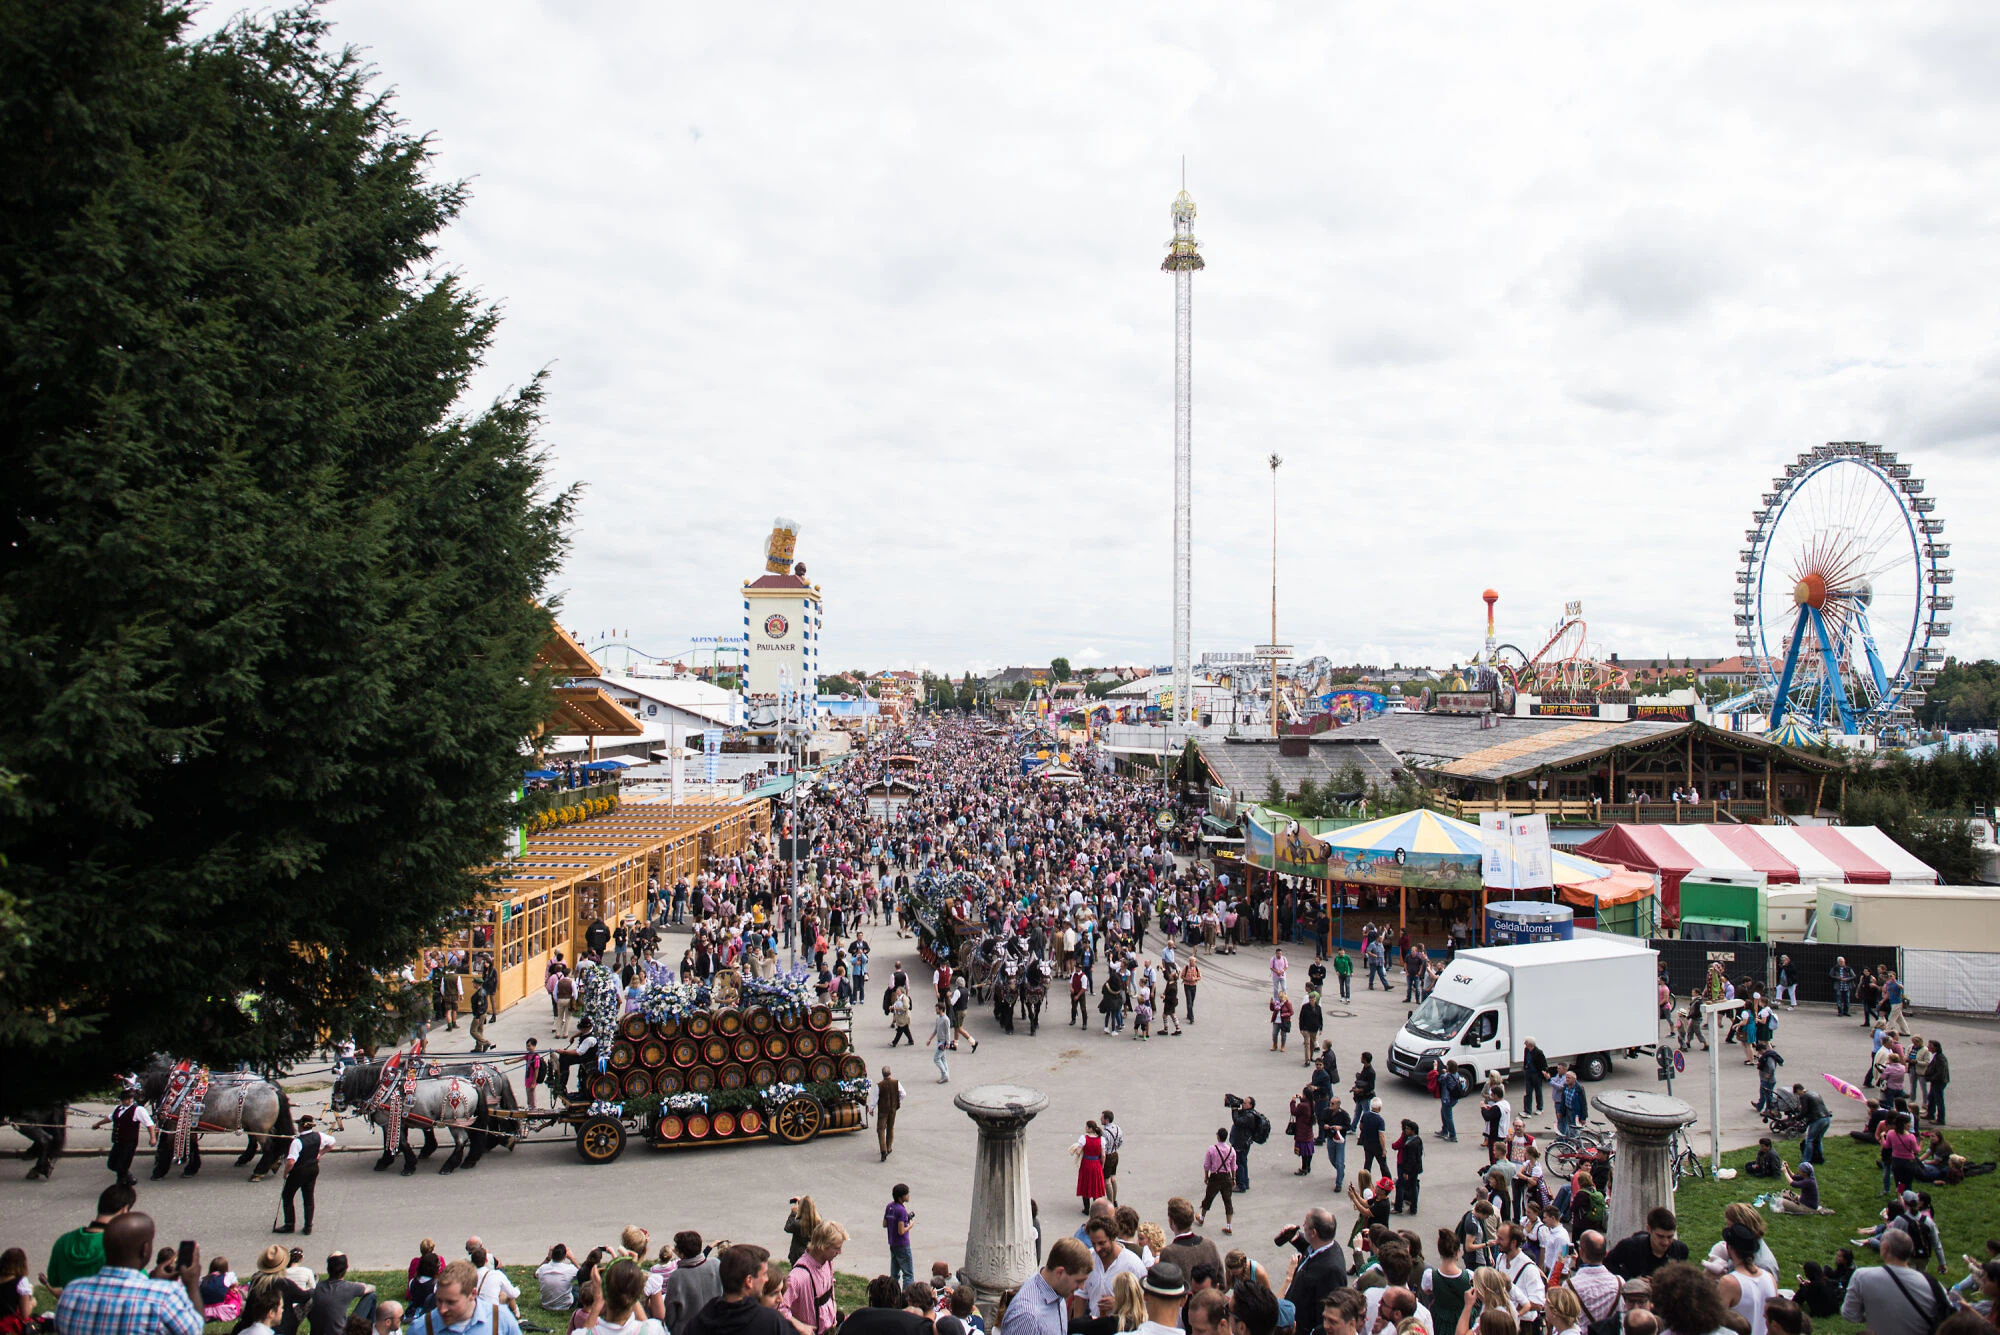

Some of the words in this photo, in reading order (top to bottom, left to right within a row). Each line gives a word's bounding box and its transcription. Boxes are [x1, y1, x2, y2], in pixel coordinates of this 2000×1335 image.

[757, 643, 796, 651] PAULANER
[1494, 920, 1553, 933] Geldautomat
[1710, 951, 1730, 961] WC
